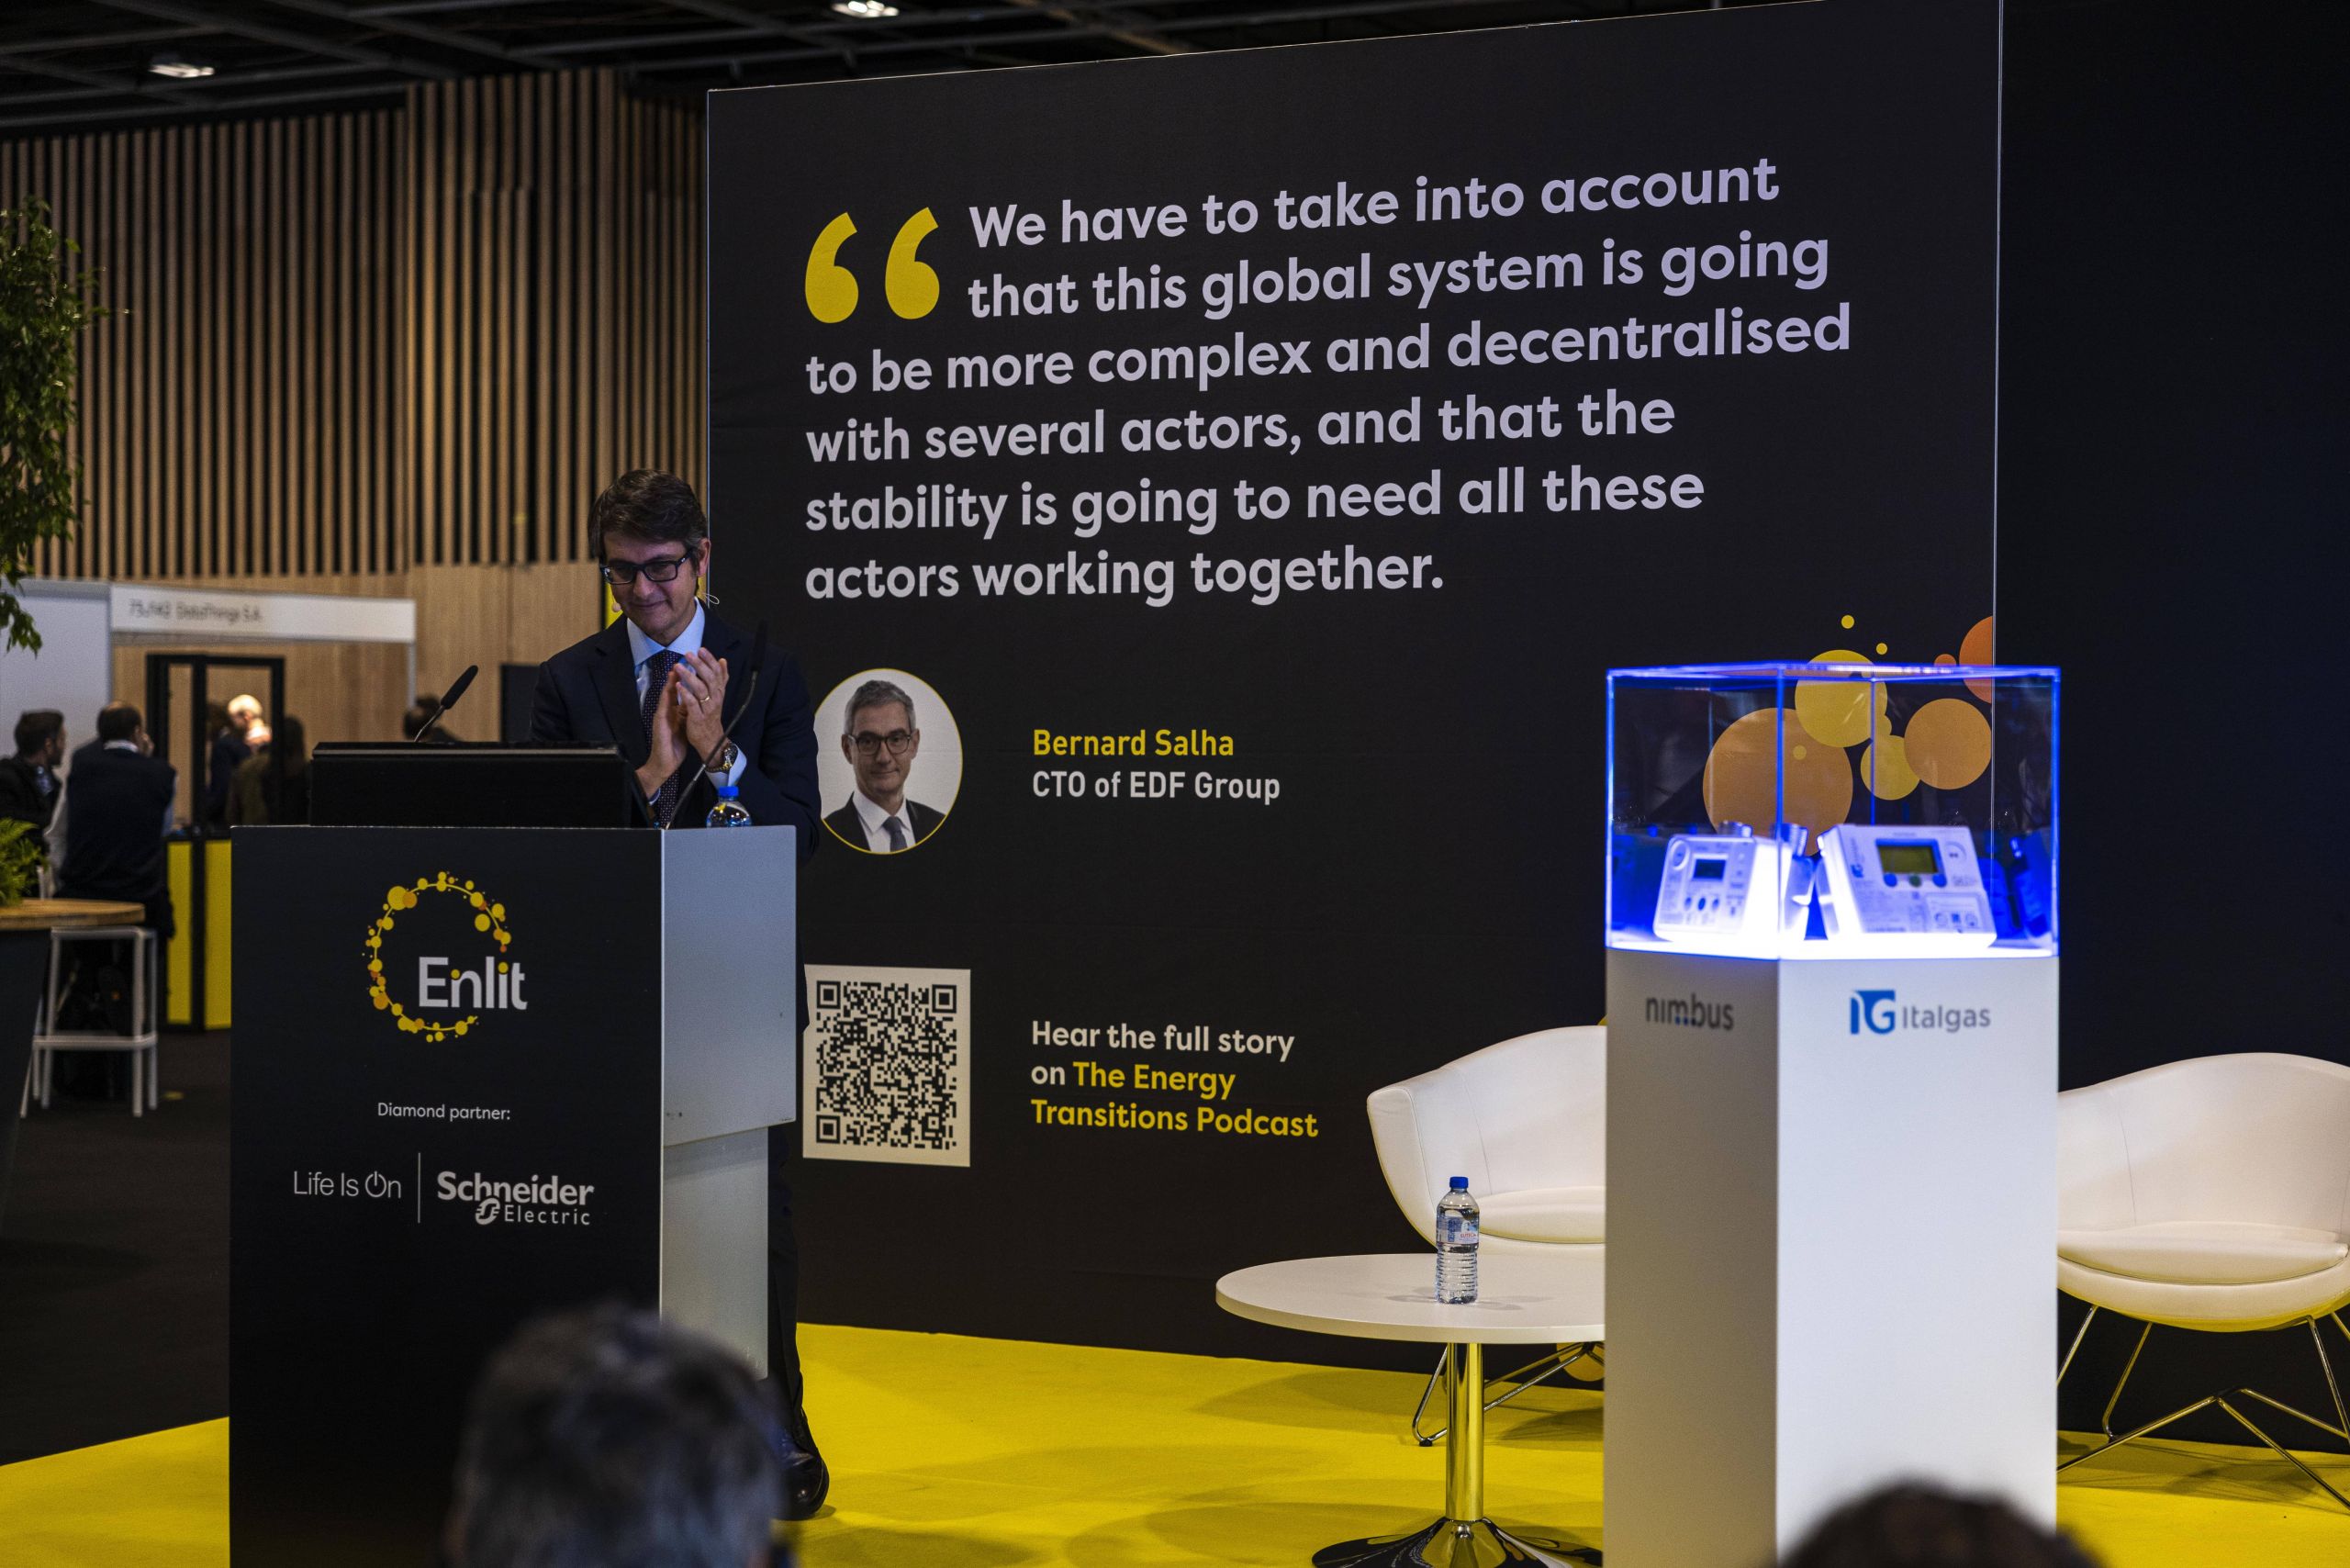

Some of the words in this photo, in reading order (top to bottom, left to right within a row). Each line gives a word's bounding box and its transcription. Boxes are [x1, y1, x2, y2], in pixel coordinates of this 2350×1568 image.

[969, 205, 1046, 247] We
[1062, 199, 1187, 242] have
[1203, 196, 1258, 234] to
[1274, 182, 1398, 230] take
[1416, 176, 1524, 221] into
[1541, 159, 1779, 213] account
[968, 274, 1079, 318] that
[1092, 264, 1186, 311] this
[1203, 253, 1370, 319] global
[1388, 252, 1583, 308] system
[1604, 239, 1643, 285] is
[1662, 230, 1828, 296] going
[806, 357, 856, 394] to
[873, 349, 932, 391] be
[948, 353, 1073, 387] more
[1089, 332, 1311, 391] complex
[1327, 323, 1429, 372] and
[1448, 302, 1849, 366] decentralised
[806, 418, 909, 462] with
[925, 409, 1103, 454] several
[1122, 410, 1300, 455] actors,
[1318, 397, 1420, 444] and
[1438, 395, 1561, 441] that
[1578, 389, 1674, 435] the
[806, 484, 1008, 539] stability
[1022, 482, 1057, 525] is
[1072, 478, 1216, 537] going
[1234, 480, 1290, 520] to
[1308, 469, 1440, 517] need
[1460, 466, 1524, 513] all
[1542, 465, 1704, 511] these
[806, 560, 958, 599] actors
[972, 550, 1173, 607] working
[1191, 545, 1443, 605] together.
[1035, 730, 1145, 755] Bernard
[1156, 730, 1233, 756] Salha
[1034, 771, 1085, 797] CTO
[1095, 771, 1120, 797] of
[1131, 772, 1185, 798] EDF
[1195, 772, 1280, 805] Group
[420, 957, 527, 1010] Enlit
[1646, 992, 1734, 1031] nimbus
[1902, 1005, 1991, 1032] Italgas
[1033, 1021, 1100, 1047] Hear
[1107, 1024, 1156, 1049] the
[1164, 1025, 1208, 1051] full
[1218, 1030, 1294, 1062] story
[1032, 1066, 1065, 1085] on
[1073, 1062, 1125, 1087] The
[1135, 1065, 1236, 1100] Energy
[378, 1103, 444, 1117] Diamond
[450, 1107, 509, 1122] partner:
[1031, 1100, 1188, 1130] Transitions
[1198, 1107, 1318, 1137] Podcast
[295, 1171, 334, 1195] Life
[341, 1173, 359, 1196] Is
[365, 1171, 401, 1198] On
[438, 1171, 594, 1205] Schneider
[505, 1204, 589, 1225] Electric
